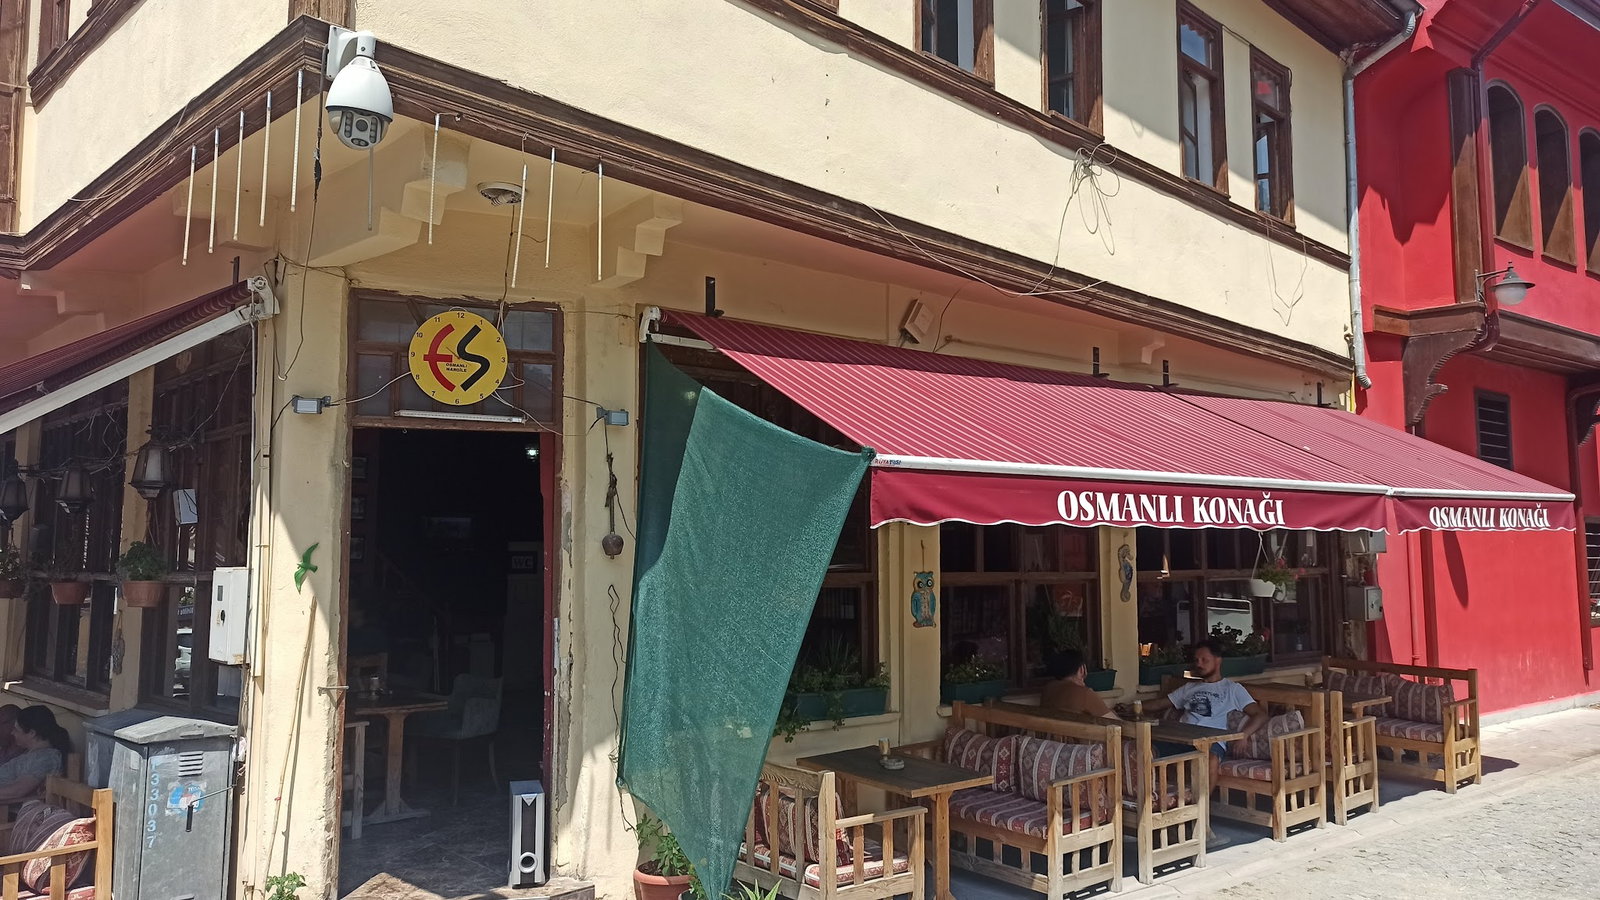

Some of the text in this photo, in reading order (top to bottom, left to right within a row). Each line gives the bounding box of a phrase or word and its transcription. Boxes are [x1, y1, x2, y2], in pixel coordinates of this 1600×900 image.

[1057, 490, 1286, 525] OSMANLI KONAĞI
[1429, 503, 1551, 527] OSMANLI KONAĞI
[512, 557, 532, 568] WC
